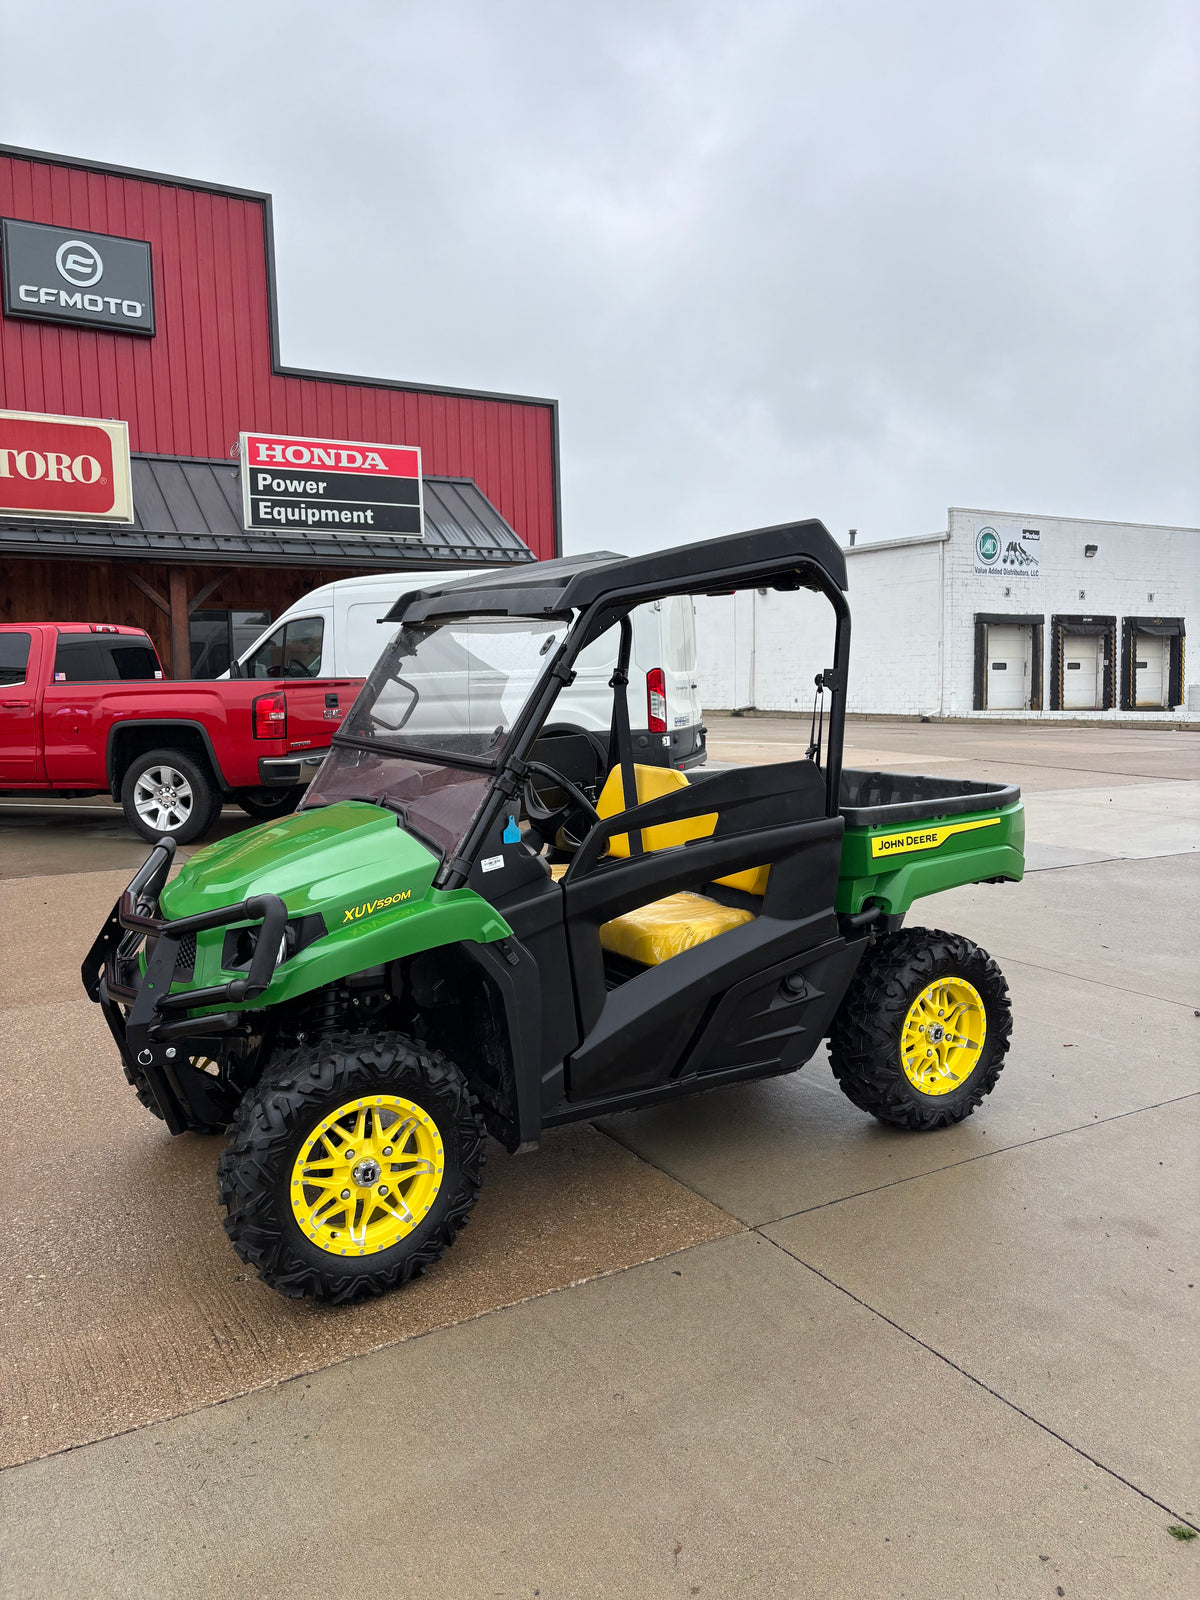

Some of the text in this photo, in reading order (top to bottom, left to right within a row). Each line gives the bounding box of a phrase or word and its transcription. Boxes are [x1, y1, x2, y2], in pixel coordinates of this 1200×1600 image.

[19, 285, 142, 318] CFMOTO
[0, 448, 102, 484] TORO
[256, 443, 389, 470] HONDA
[257, 473, 327, 494] Power
[258, 502, 374, 525] Equipment
[974, 566, 988, 575] Value
[988, 567, 1003, 575] Added
[1030, 569, 1039, 577] LLC
[878, 833, 938, 850] JOHN DEERE
[342, 889, 412, 924] XUV590M
